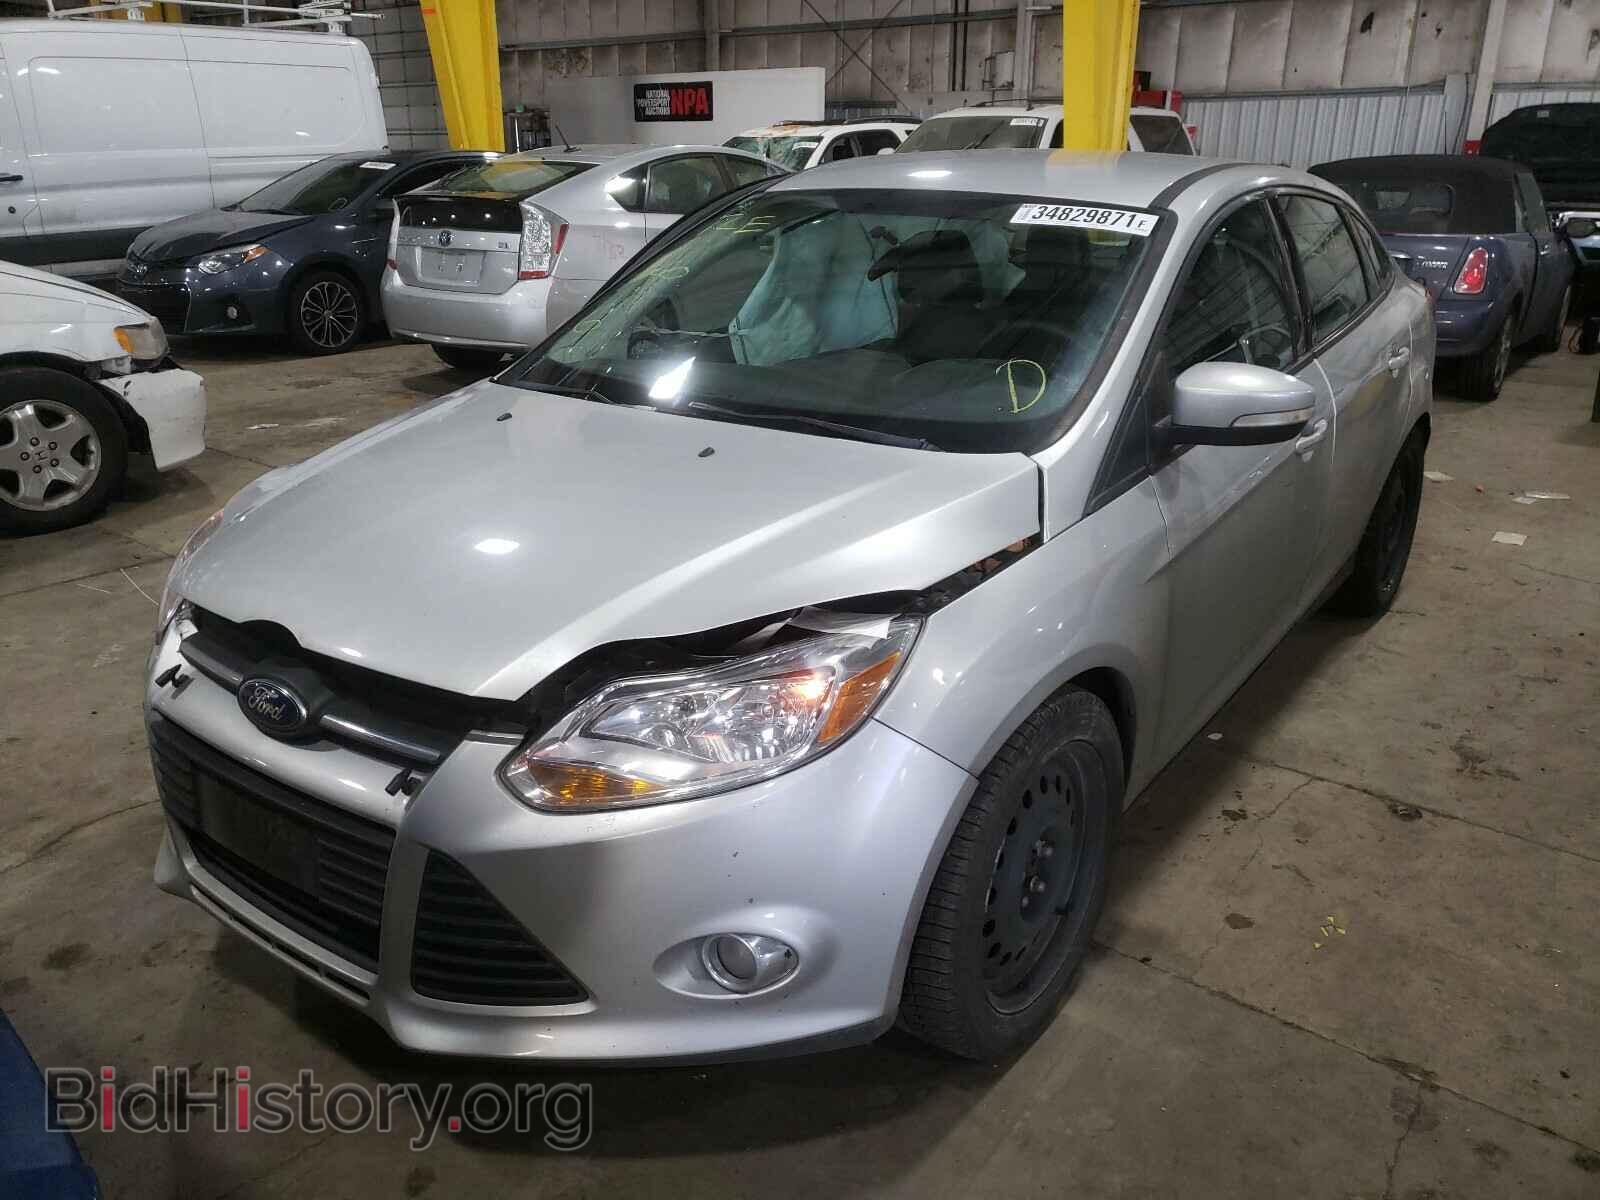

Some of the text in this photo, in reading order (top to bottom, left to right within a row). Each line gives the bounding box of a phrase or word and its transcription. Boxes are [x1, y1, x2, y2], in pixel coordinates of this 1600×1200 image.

[646, 89, 670, 99] NATIONAL
[671, 88, 709, 115] NPA
[1032, 205, 1137, 228] 34829871
[996, 357, 1046, 413] D
[248, 686, 286, 720] Ford
